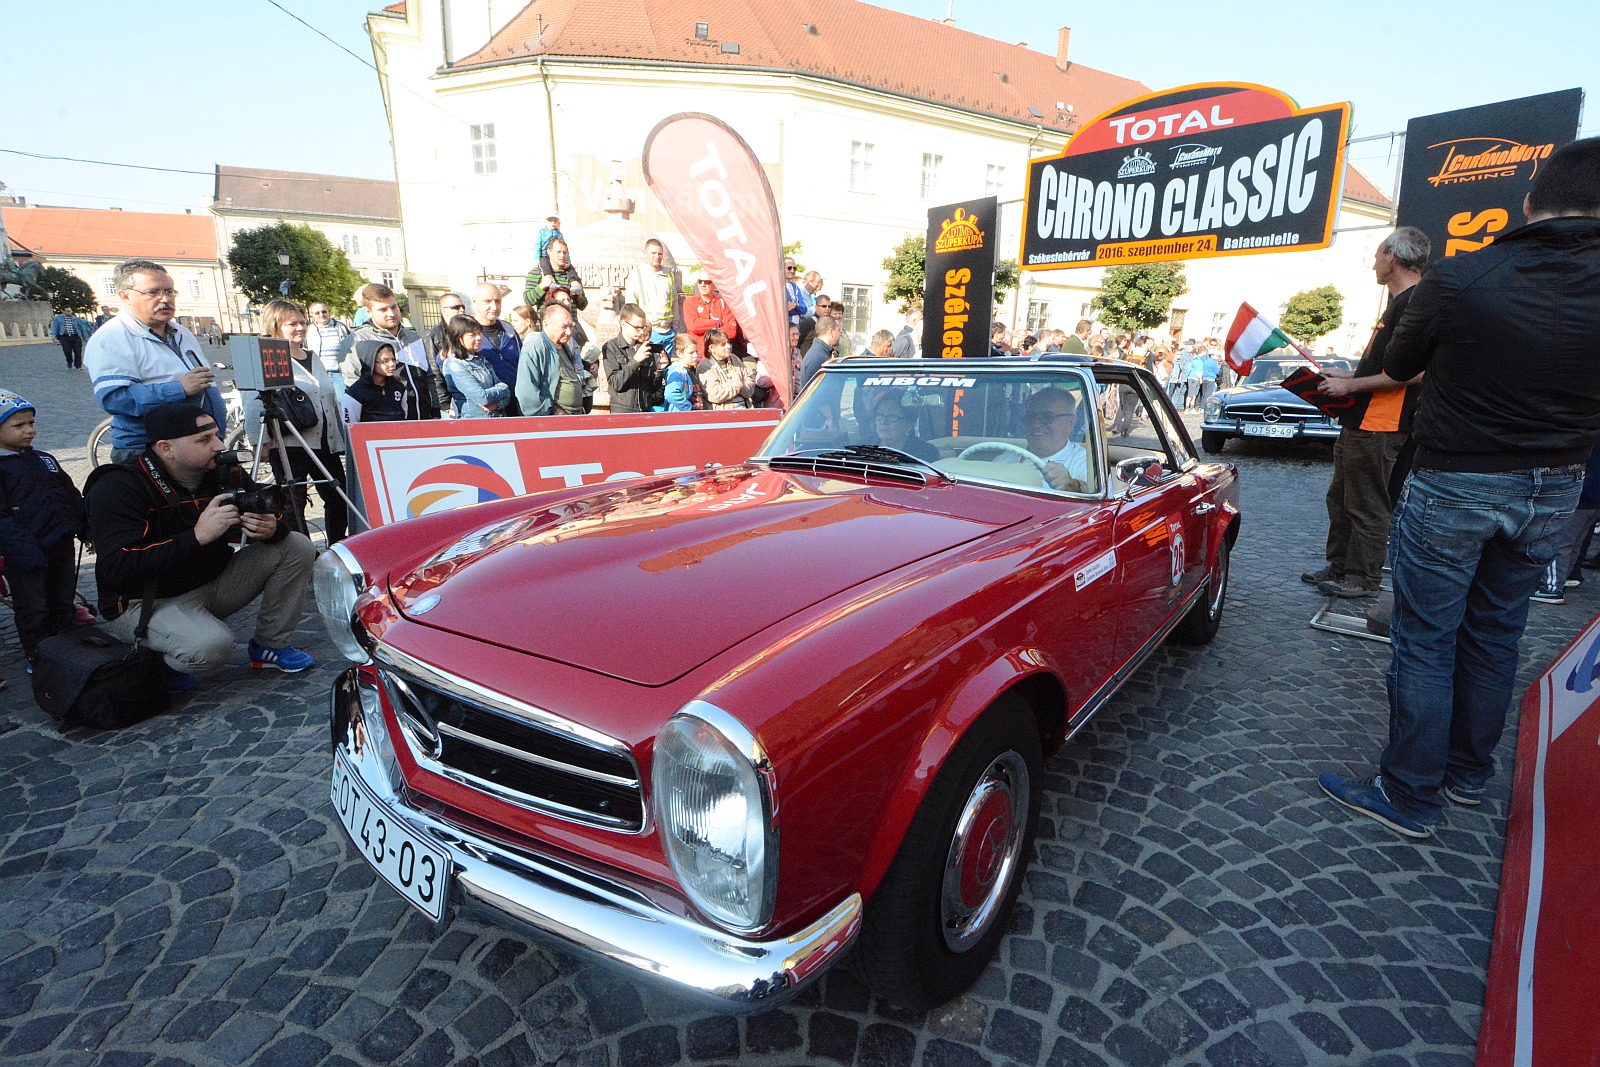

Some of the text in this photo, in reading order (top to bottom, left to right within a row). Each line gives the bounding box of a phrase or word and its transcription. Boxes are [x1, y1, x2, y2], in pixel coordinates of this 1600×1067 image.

[1109, 105, 1235, 144] TOTAL
[1037, 118, 1323, 240] CHRONO CLASSIC
[1443, 170, 1516, 185] TIMING
[689, 139, 767, 317] TOTAL
[935, 233, 984, 250] SZUPERKUPA
[1099, 239, 1214, 260] 2016. szeptember 24.
[1223, 232, 1300, 250] Balatonlelle
[1028, 250, 1091, 265] Székesfehérvár
[862, 377, 977, 388] MBCM
